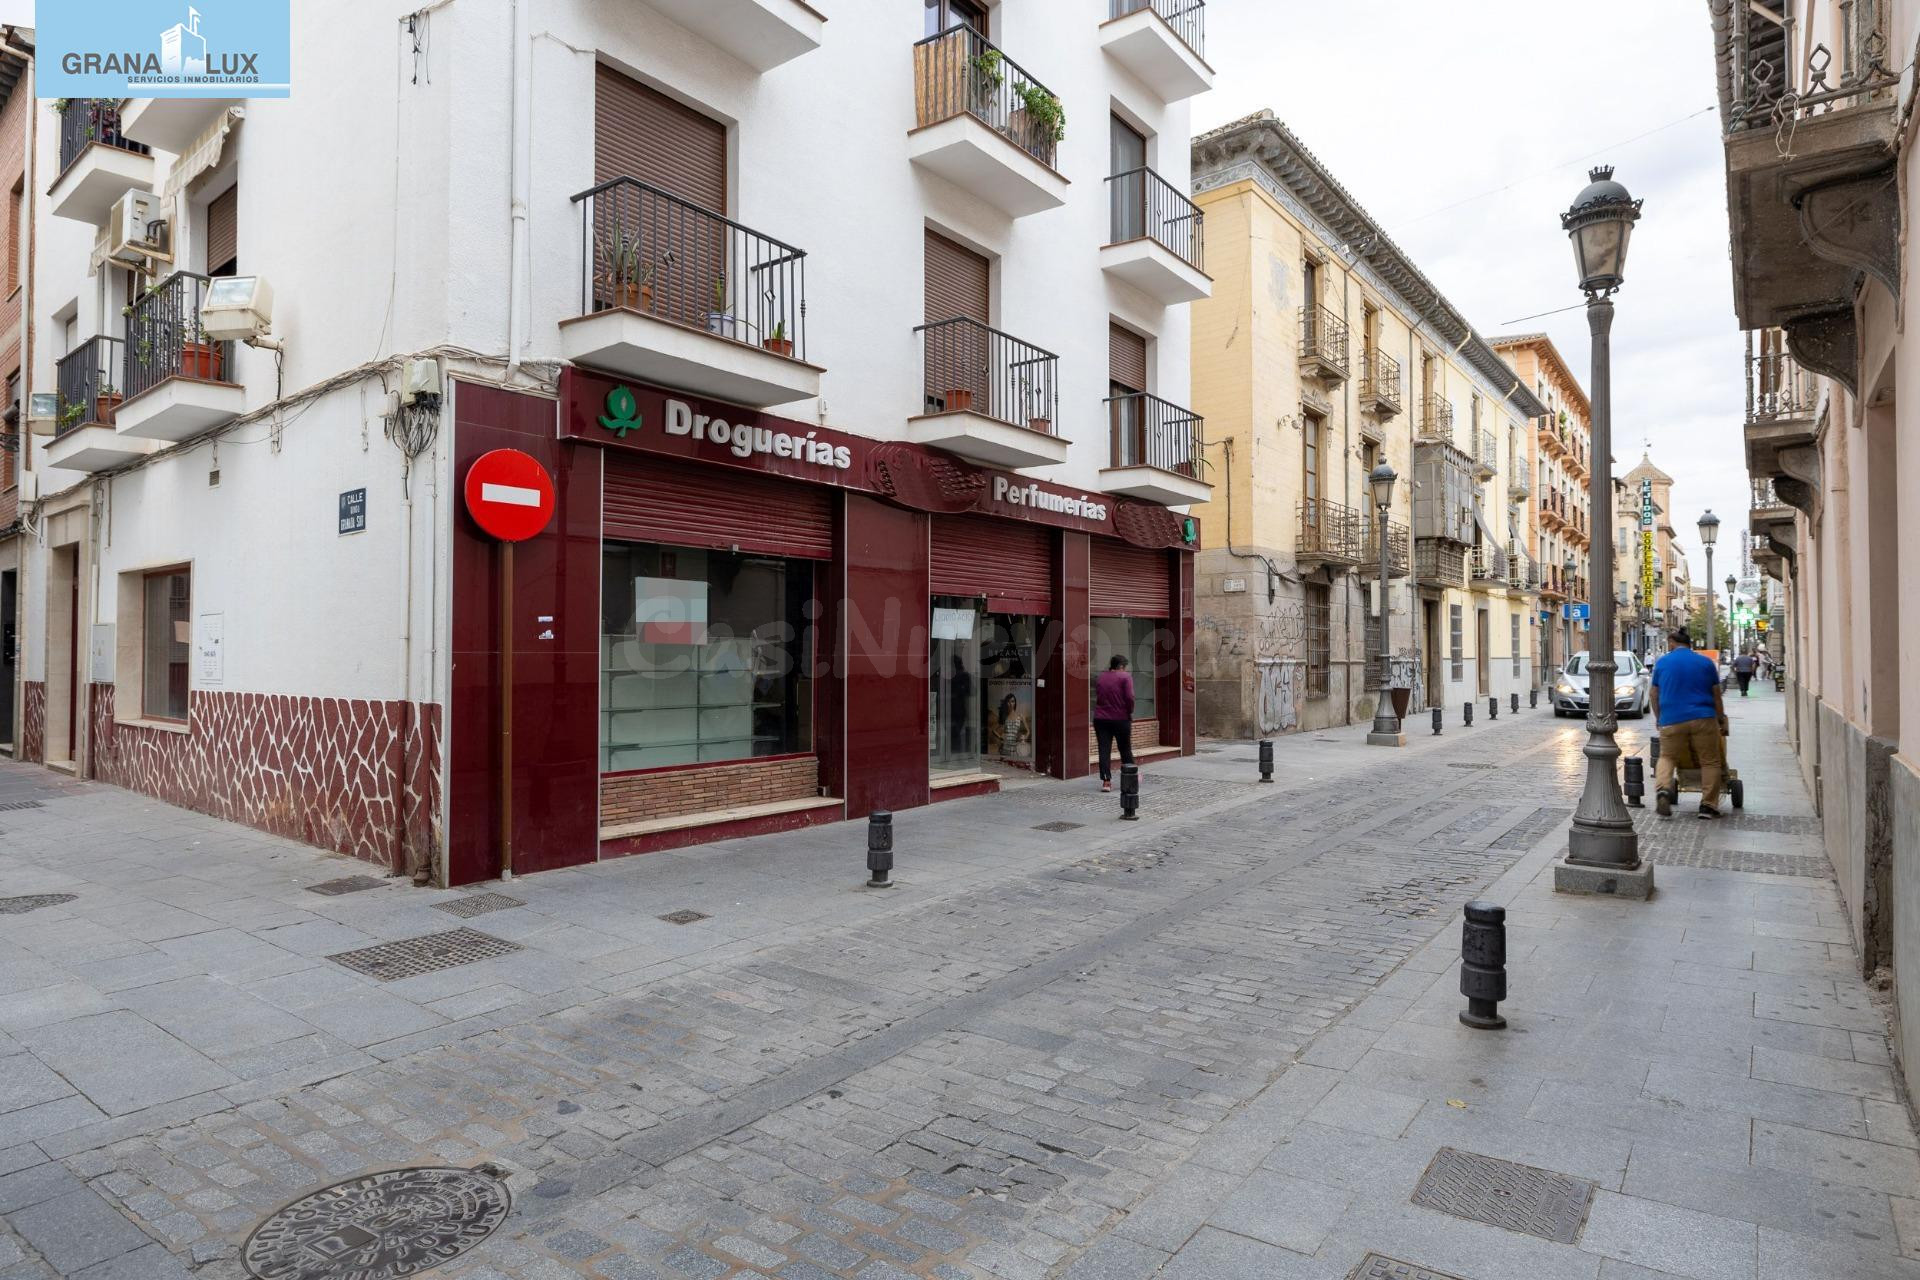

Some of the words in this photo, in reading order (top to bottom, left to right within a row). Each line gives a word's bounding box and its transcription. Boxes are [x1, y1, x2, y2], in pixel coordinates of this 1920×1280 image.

[664, 398, 851, 469] Droguerías
[993, 476, 1107, 520] Perfumerías
[1643, 479, 1652, 525] TEJIDOS
